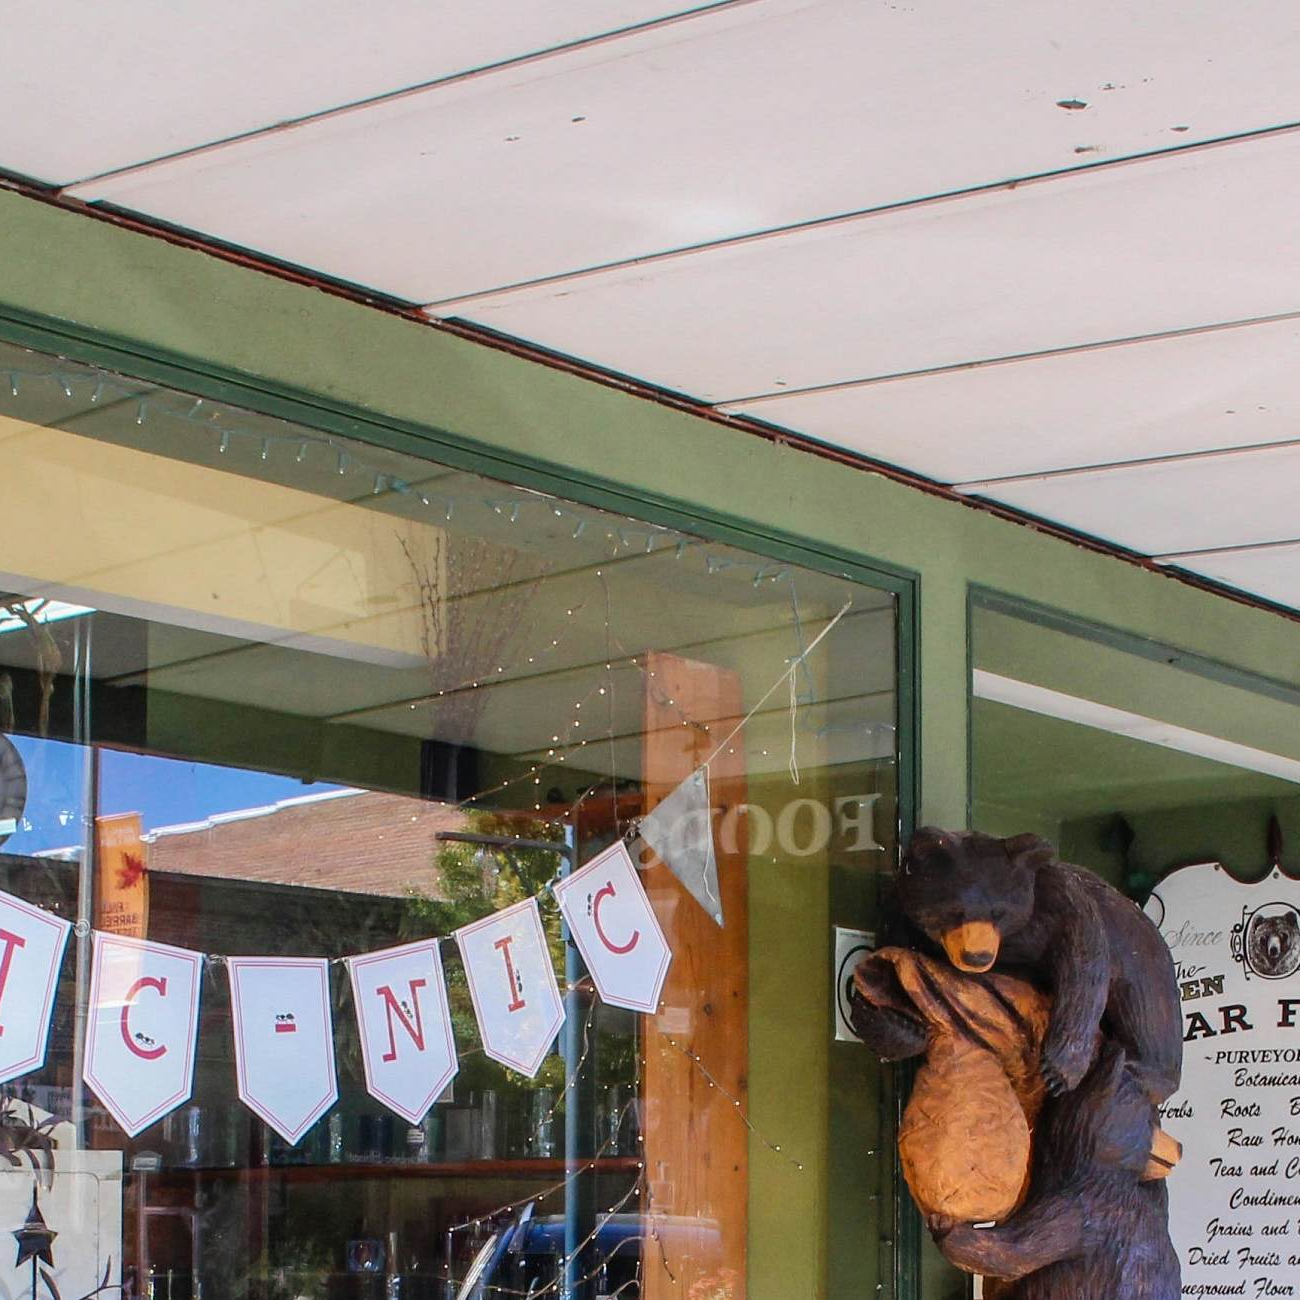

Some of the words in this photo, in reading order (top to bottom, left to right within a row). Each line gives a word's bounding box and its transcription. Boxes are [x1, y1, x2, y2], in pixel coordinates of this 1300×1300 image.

[1163, 920, 1224, 949] Since
[1180, 974, 1225, 1001] EN
[1183, 1003, 1254, 1042] AR
[1219, 1097, 1262, 1120] Roots
[1226, 1127, 1265, 1148] Raw
[1208, 1157, 1244, 1178] Teas
[1249, 1159, 1279, 1177] and
[1205, 1217, 1255, 1244] Grains
[1260, 1218, 1290, 1237] and
[1187, 1246, 1230, 1266] Dried
[1236, 1246, 1282, 1270] Fruits
[1181, 1279, 1246, 1300] neground
[1252, 1276, 1295, 1300] Flour
